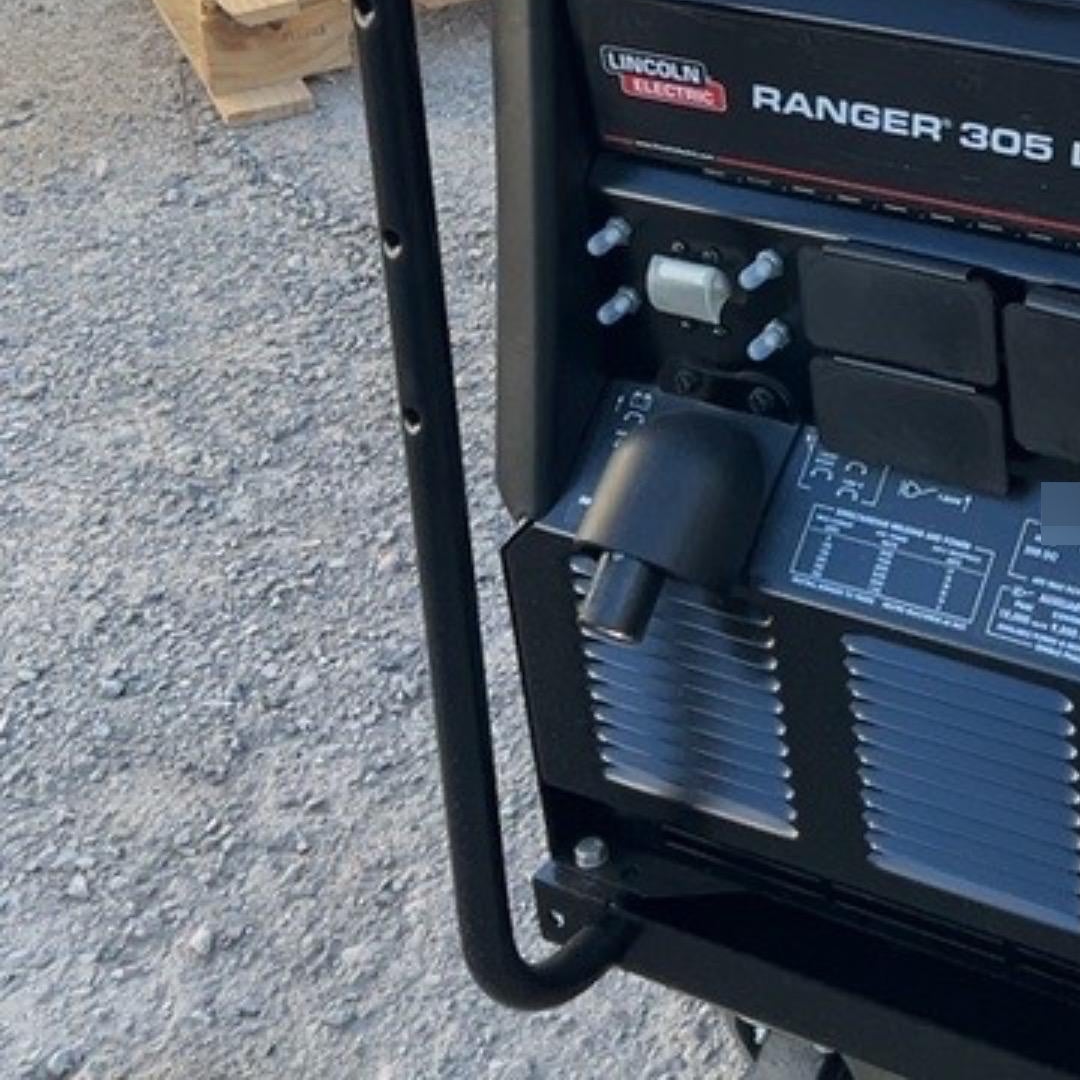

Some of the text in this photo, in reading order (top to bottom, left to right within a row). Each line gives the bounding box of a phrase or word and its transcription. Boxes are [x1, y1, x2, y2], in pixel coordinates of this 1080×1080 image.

[607, 52, 700, 84] LINCOLN
[631, 76, 716, 106] ELECTRIC
[751, 83, 943, 142] RANGER
[958, 121, 1054, 161] 305
